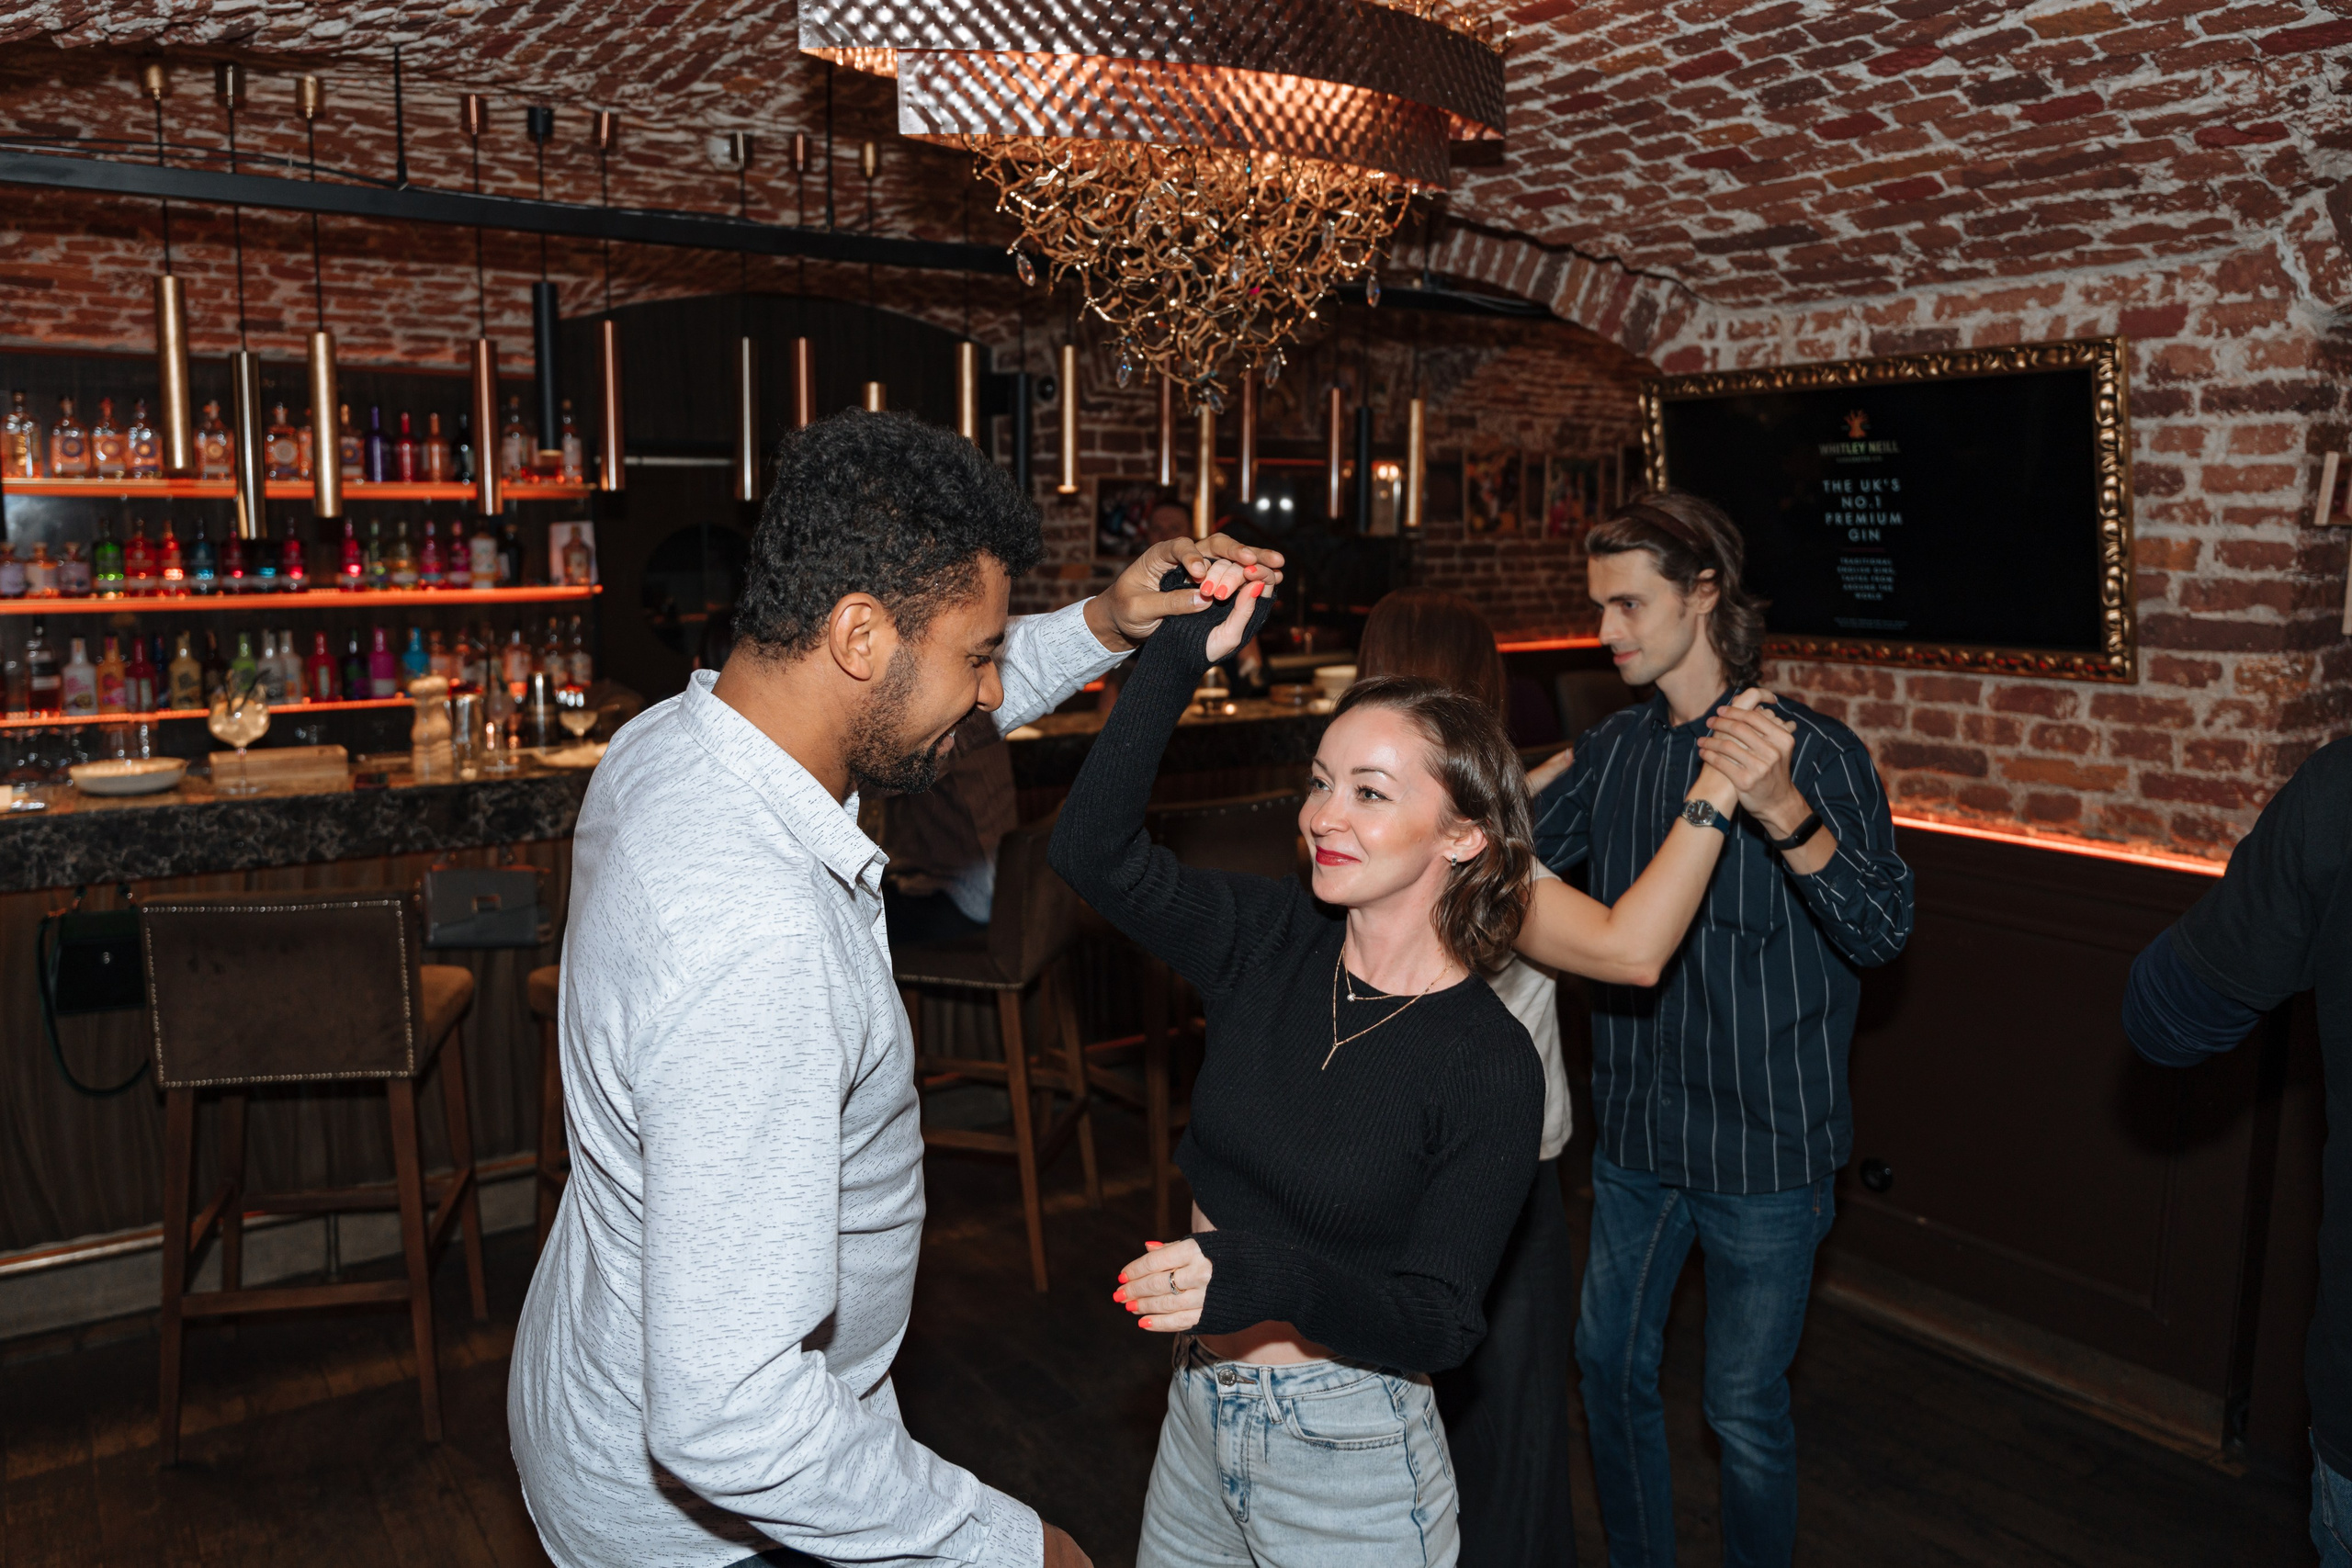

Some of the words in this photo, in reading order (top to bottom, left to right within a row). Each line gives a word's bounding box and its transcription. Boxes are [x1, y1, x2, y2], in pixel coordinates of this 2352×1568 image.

[1819, 442, 1866, 456] WHITLEY
[1823, 479, 1853, 493] THE
[1860, 478, 1901, 493] UK'S
[1841, 495, 1882, 509] NO.1
[1825, 512, 1903, 526] PREMIUM
[1848, 528, 1881, 542] GIN
